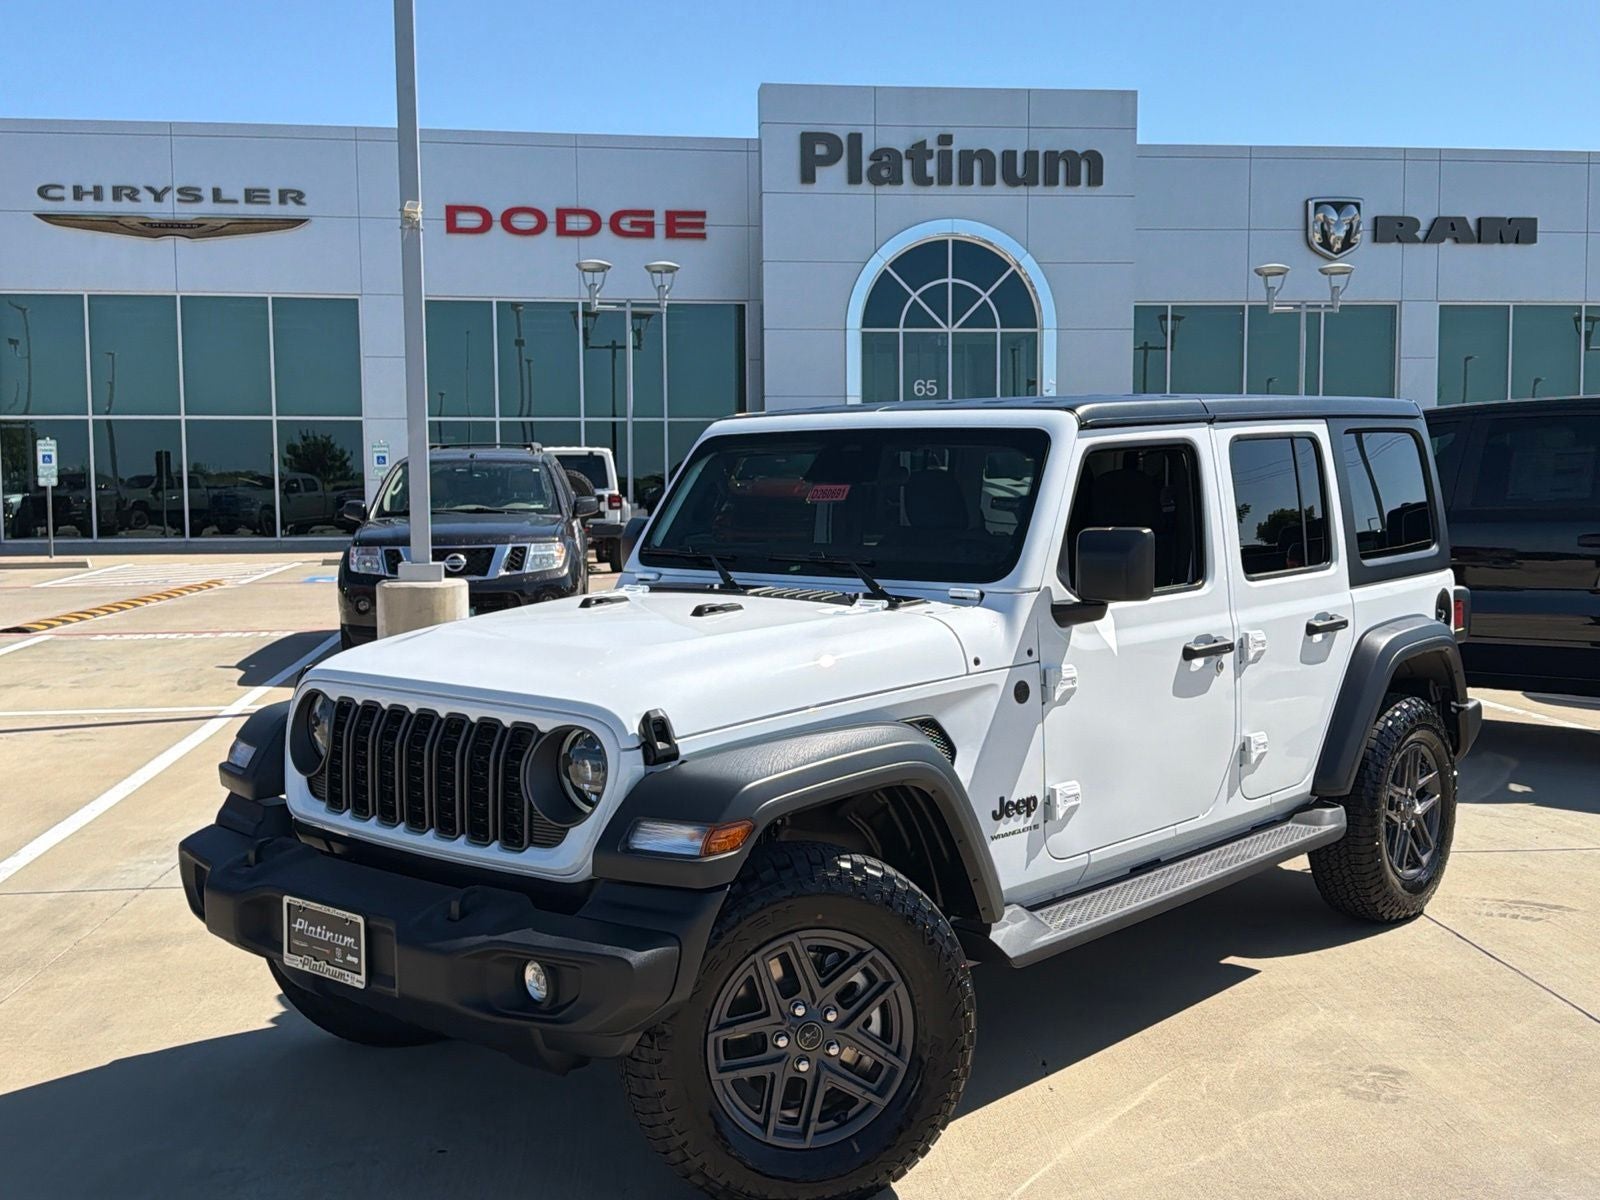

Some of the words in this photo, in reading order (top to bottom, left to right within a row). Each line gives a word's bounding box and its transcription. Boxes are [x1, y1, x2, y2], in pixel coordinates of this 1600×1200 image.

[800, 131, 1104, 188] Platinum
[36, 183, 307, 206] CHRYSLER
[445, 204, 707, 240] DODGE
[1373, 215, 1538, 244] RAM
[913, 379, 938, 397] 65
[991, 795, 1038, 821] Jeep
[291, 918, 359, 950] Platinum
[302, 956, 350, 982] Platinum
